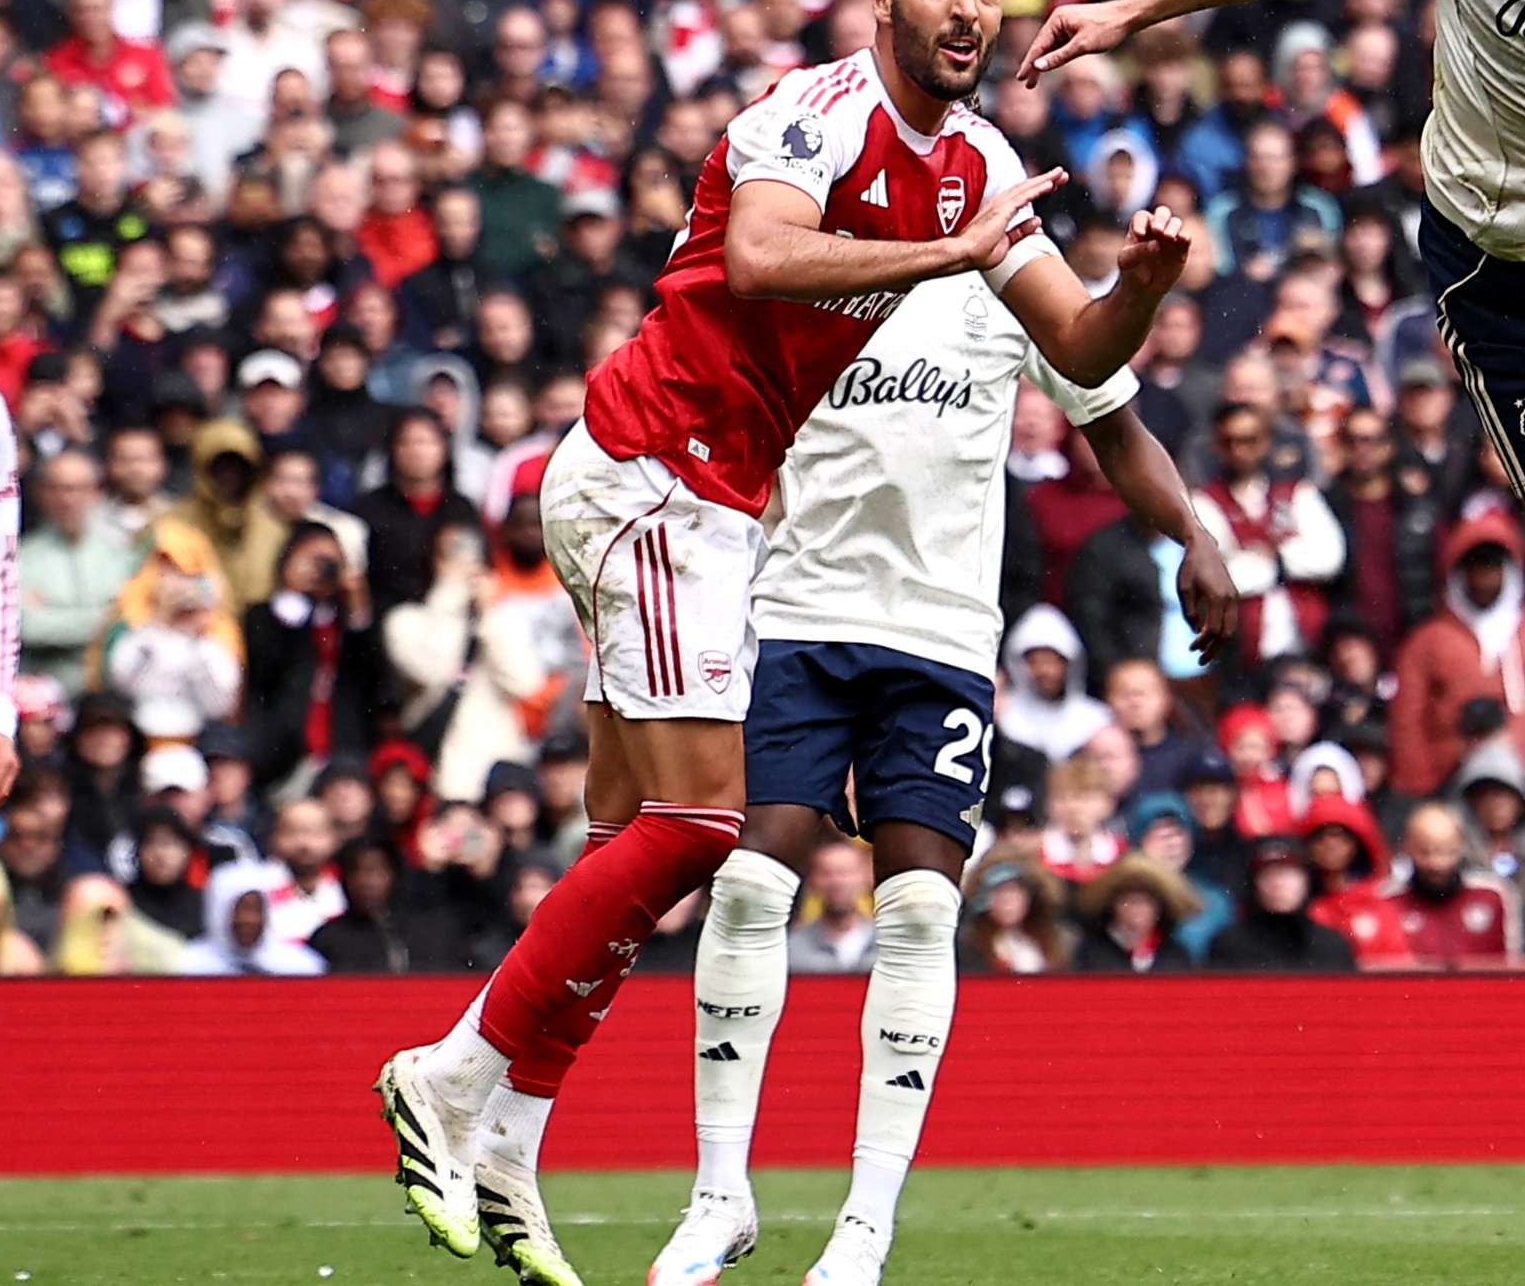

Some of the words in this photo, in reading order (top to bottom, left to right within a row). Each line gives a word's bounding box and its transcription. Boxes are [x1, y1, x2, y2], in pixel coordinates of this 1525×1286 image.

[828, 356, 974, 419] Bally's
[697, 998, 761, 1019] NFFC
[879, 1028, 941, 1048] NFFC
